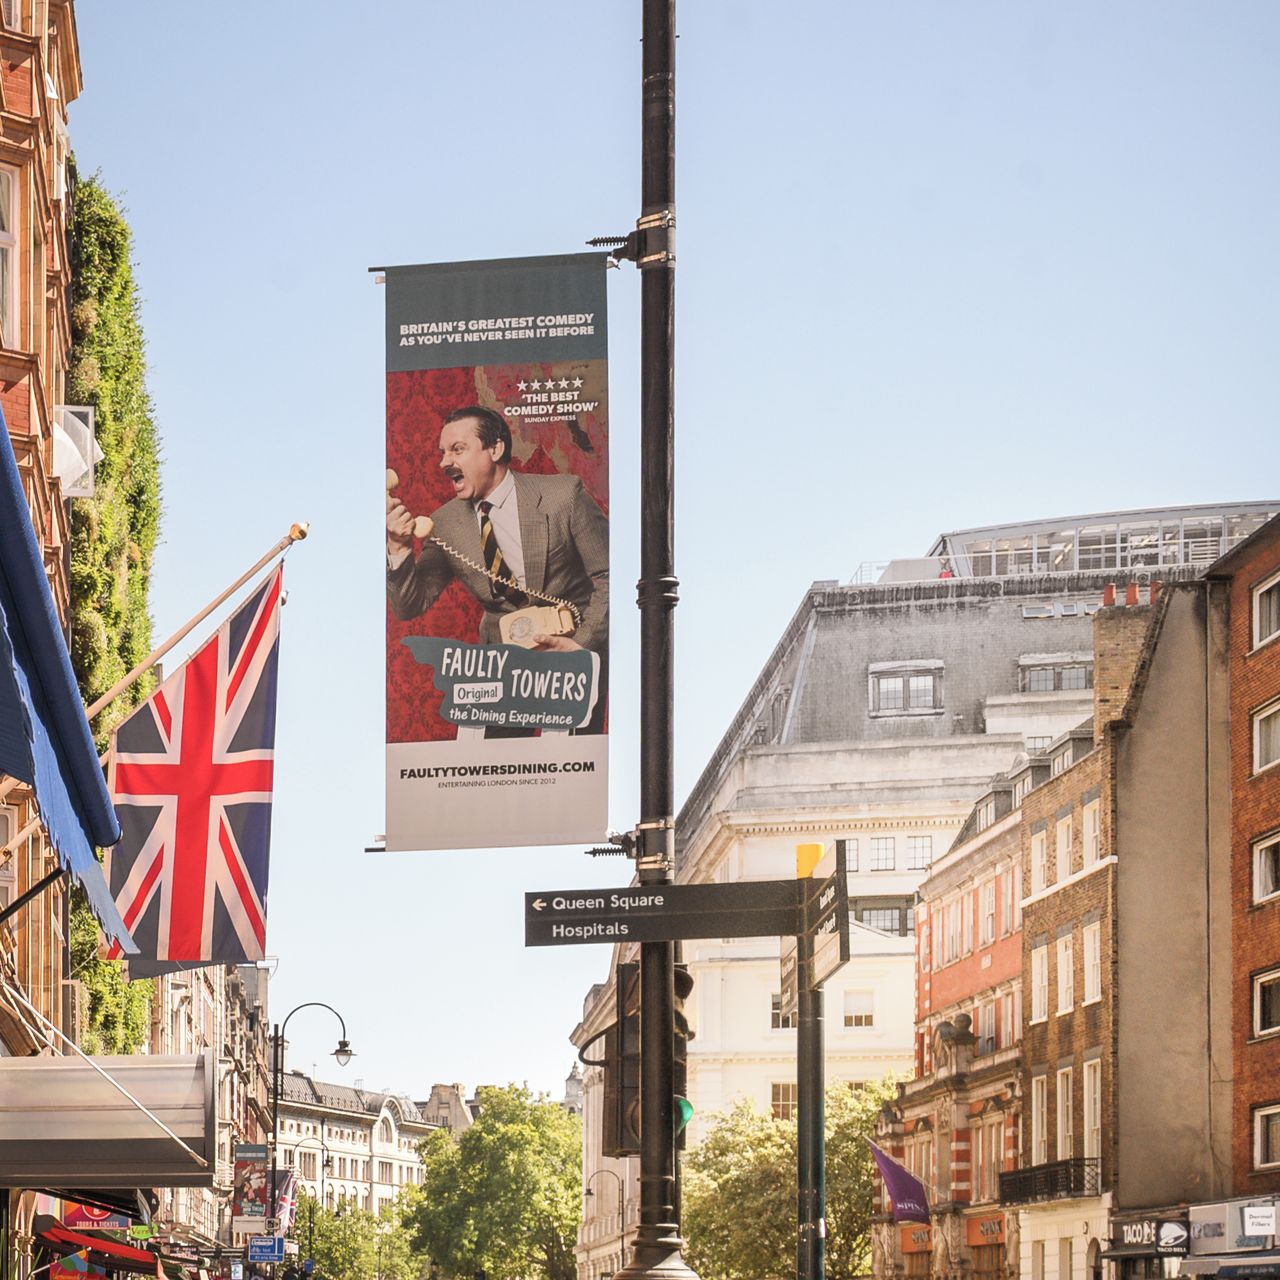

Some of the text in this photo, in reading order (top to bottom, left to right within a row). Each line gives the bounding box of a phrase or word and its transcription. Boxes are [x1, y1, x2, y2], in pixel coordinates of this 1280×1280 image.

[399, 313, 594, 336] BRITAIN'S GREATEST COMEDY
[399, 325, 595, 347] AS YOU'VE NEVER SEEN IT BEFORE
[521, 391, 580, 404] 'THE BEST
[503, 402, 599, 417] COMEDY SHOW'
[524, 414, 577, 424] SUNDAY EXPRESS
[441, 648, 509, 679] FAULTY
[457, 686, 498, 703] Original
[511, 669, 587, 702] TOWERS
[449, 708, 573, 726] the Dining Experience
[400, 761, 595, 779] FAULTYTOWERSDINING.COM
[438, 779, 486, 789] ENTERTAINING
[539, 777, 557, 785] 2012
[552, 893, 664, 911] Queen Square
[552, 921, 629, 938] Hospitals
[1123, 1222, 1143, 1244] TACO
